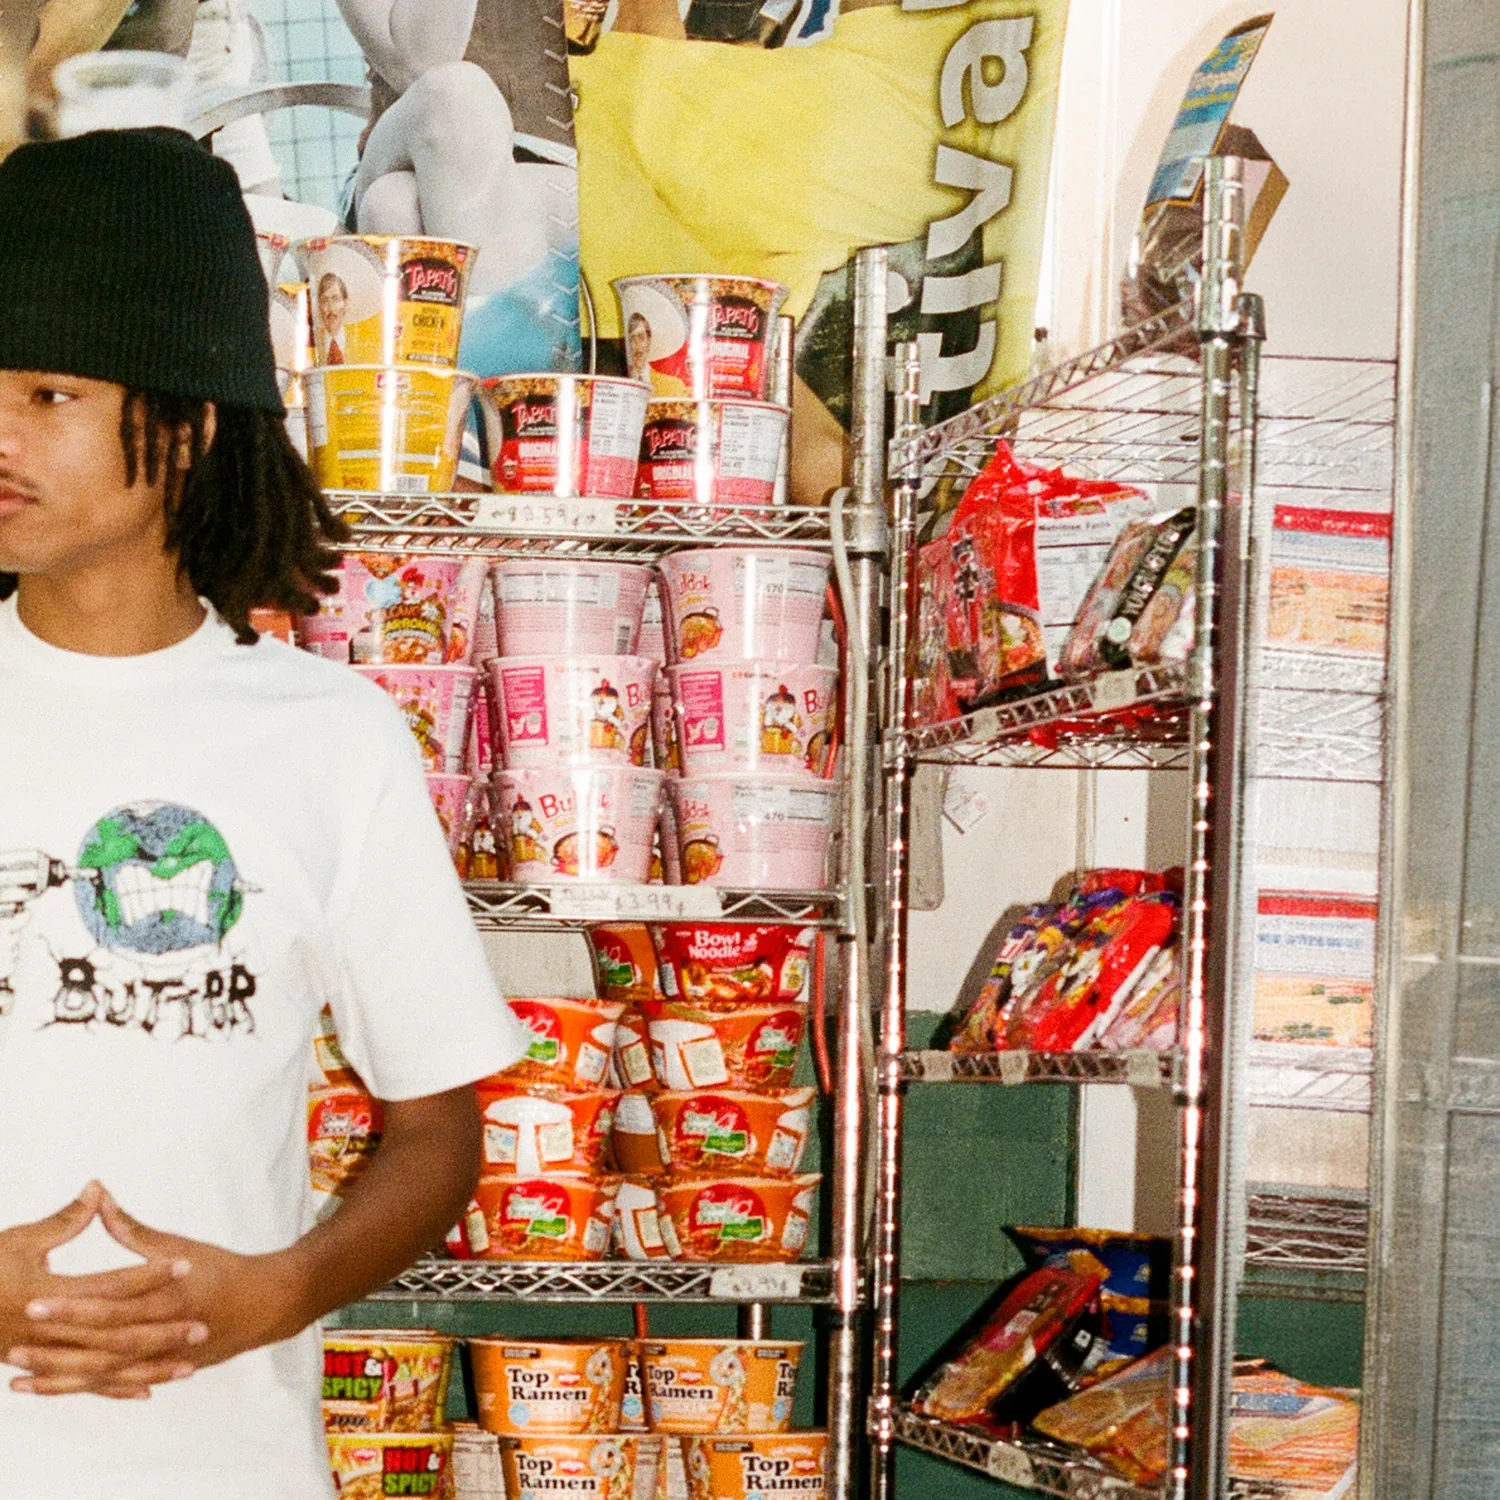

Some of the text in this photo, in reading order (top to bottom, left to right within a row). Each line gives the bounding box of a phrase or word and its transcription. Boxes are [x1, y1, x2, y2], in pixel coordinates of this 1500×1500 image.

[695, 929, 741, 946] Bowl
[688, 945, 743, 960] Noodle
[508, 1366, 550, 1387] Top
[323, 1377, 382, 1399] SPICY
[511, 1385, 588, 1401] Ramen
[650, 1384, 715, 1401] Ramen
[384, 1447, 428, 1473] HOT
[516, 1454, 555, 1474] Top
[743, 1455, 791, 1475] Top
[518, 1474, 597, 1491] Ramen
[746, 1474, 823, 1490] Ramen
